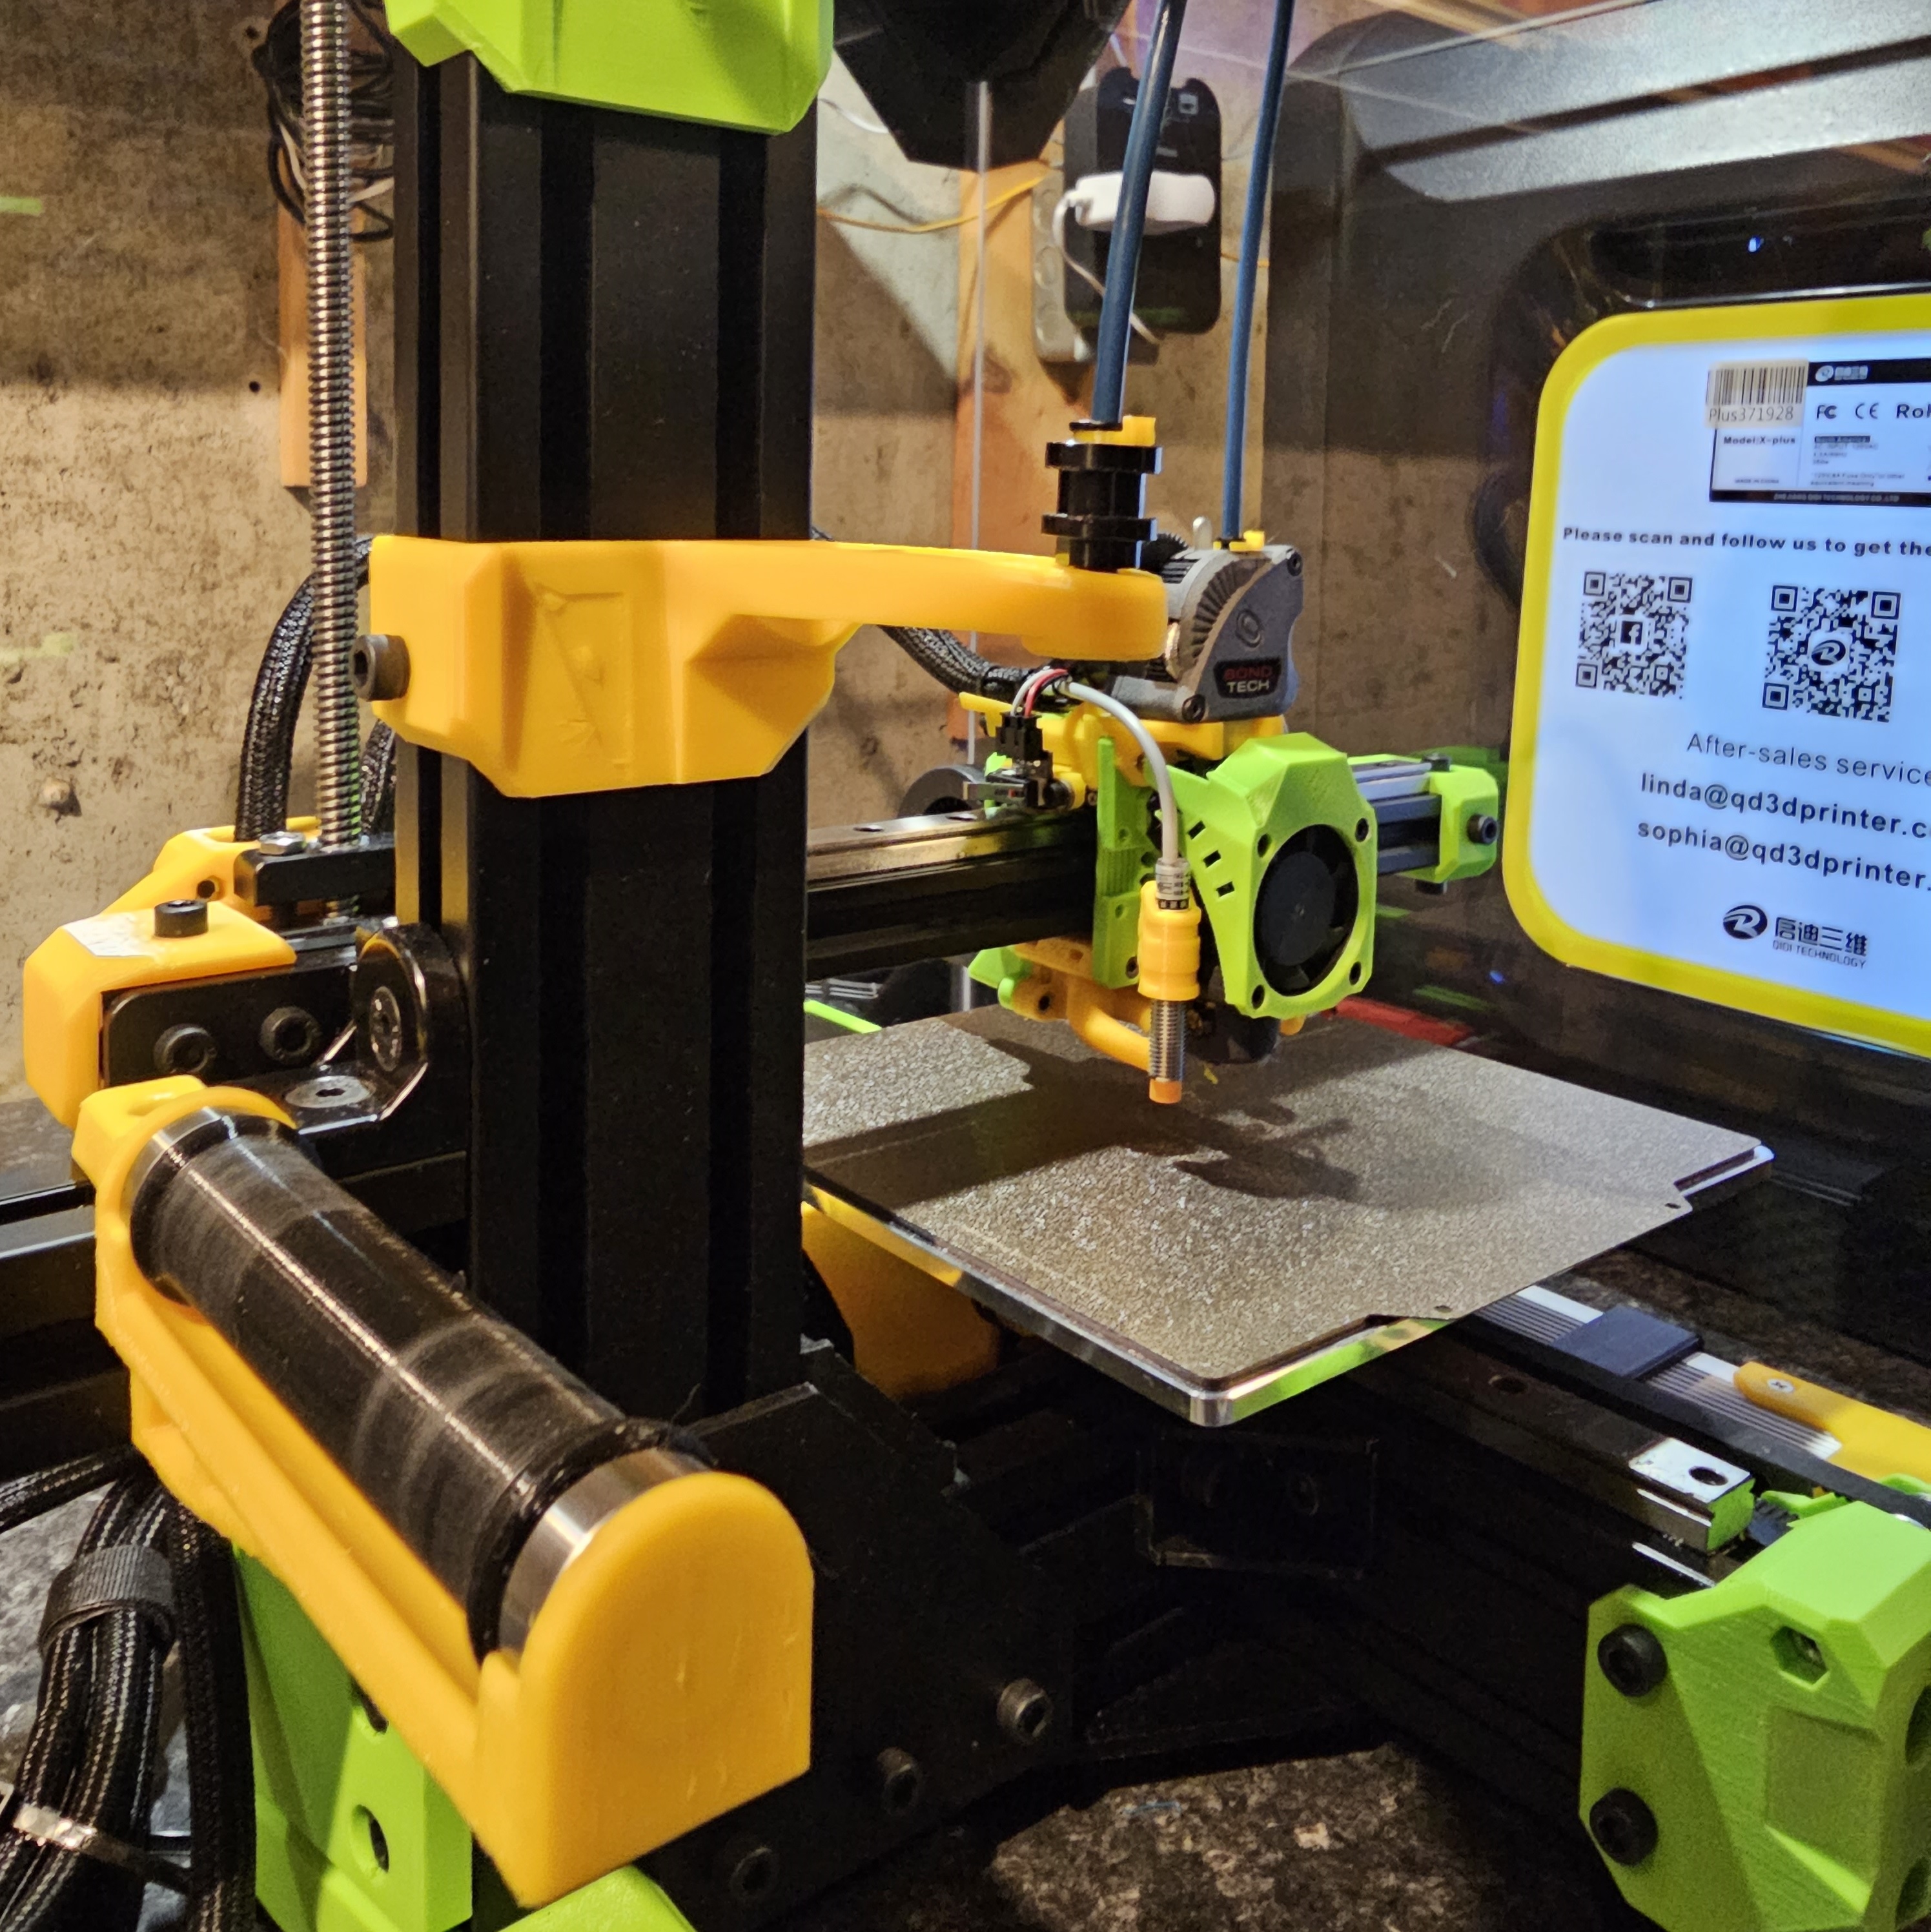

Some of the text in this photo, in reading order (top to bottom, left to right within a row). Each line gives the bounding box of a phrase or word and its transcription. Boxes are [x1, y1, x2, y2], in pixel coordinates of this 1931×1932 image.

[1709, 405, 1794, 423] Plus371928
[1564, 527, 1622, 542] Please
[1629, 533, 1673, 545] scan
[1679, 533, 1715, 547] and
[1722, 533, 1786, 549] follow
[1793, 540, 1817, 551] us
[1825, 538, 1846, 553] to
[1854, 540, 1891, 557] get
[1227, 680, 1269, 693] TECH
[1686, 733, 1827, 771] After-sales
[1640, 772, 1931, 839] linda@qd3dprinter.c
[1796, 945, 1866, 969] TECHNOLOGY
